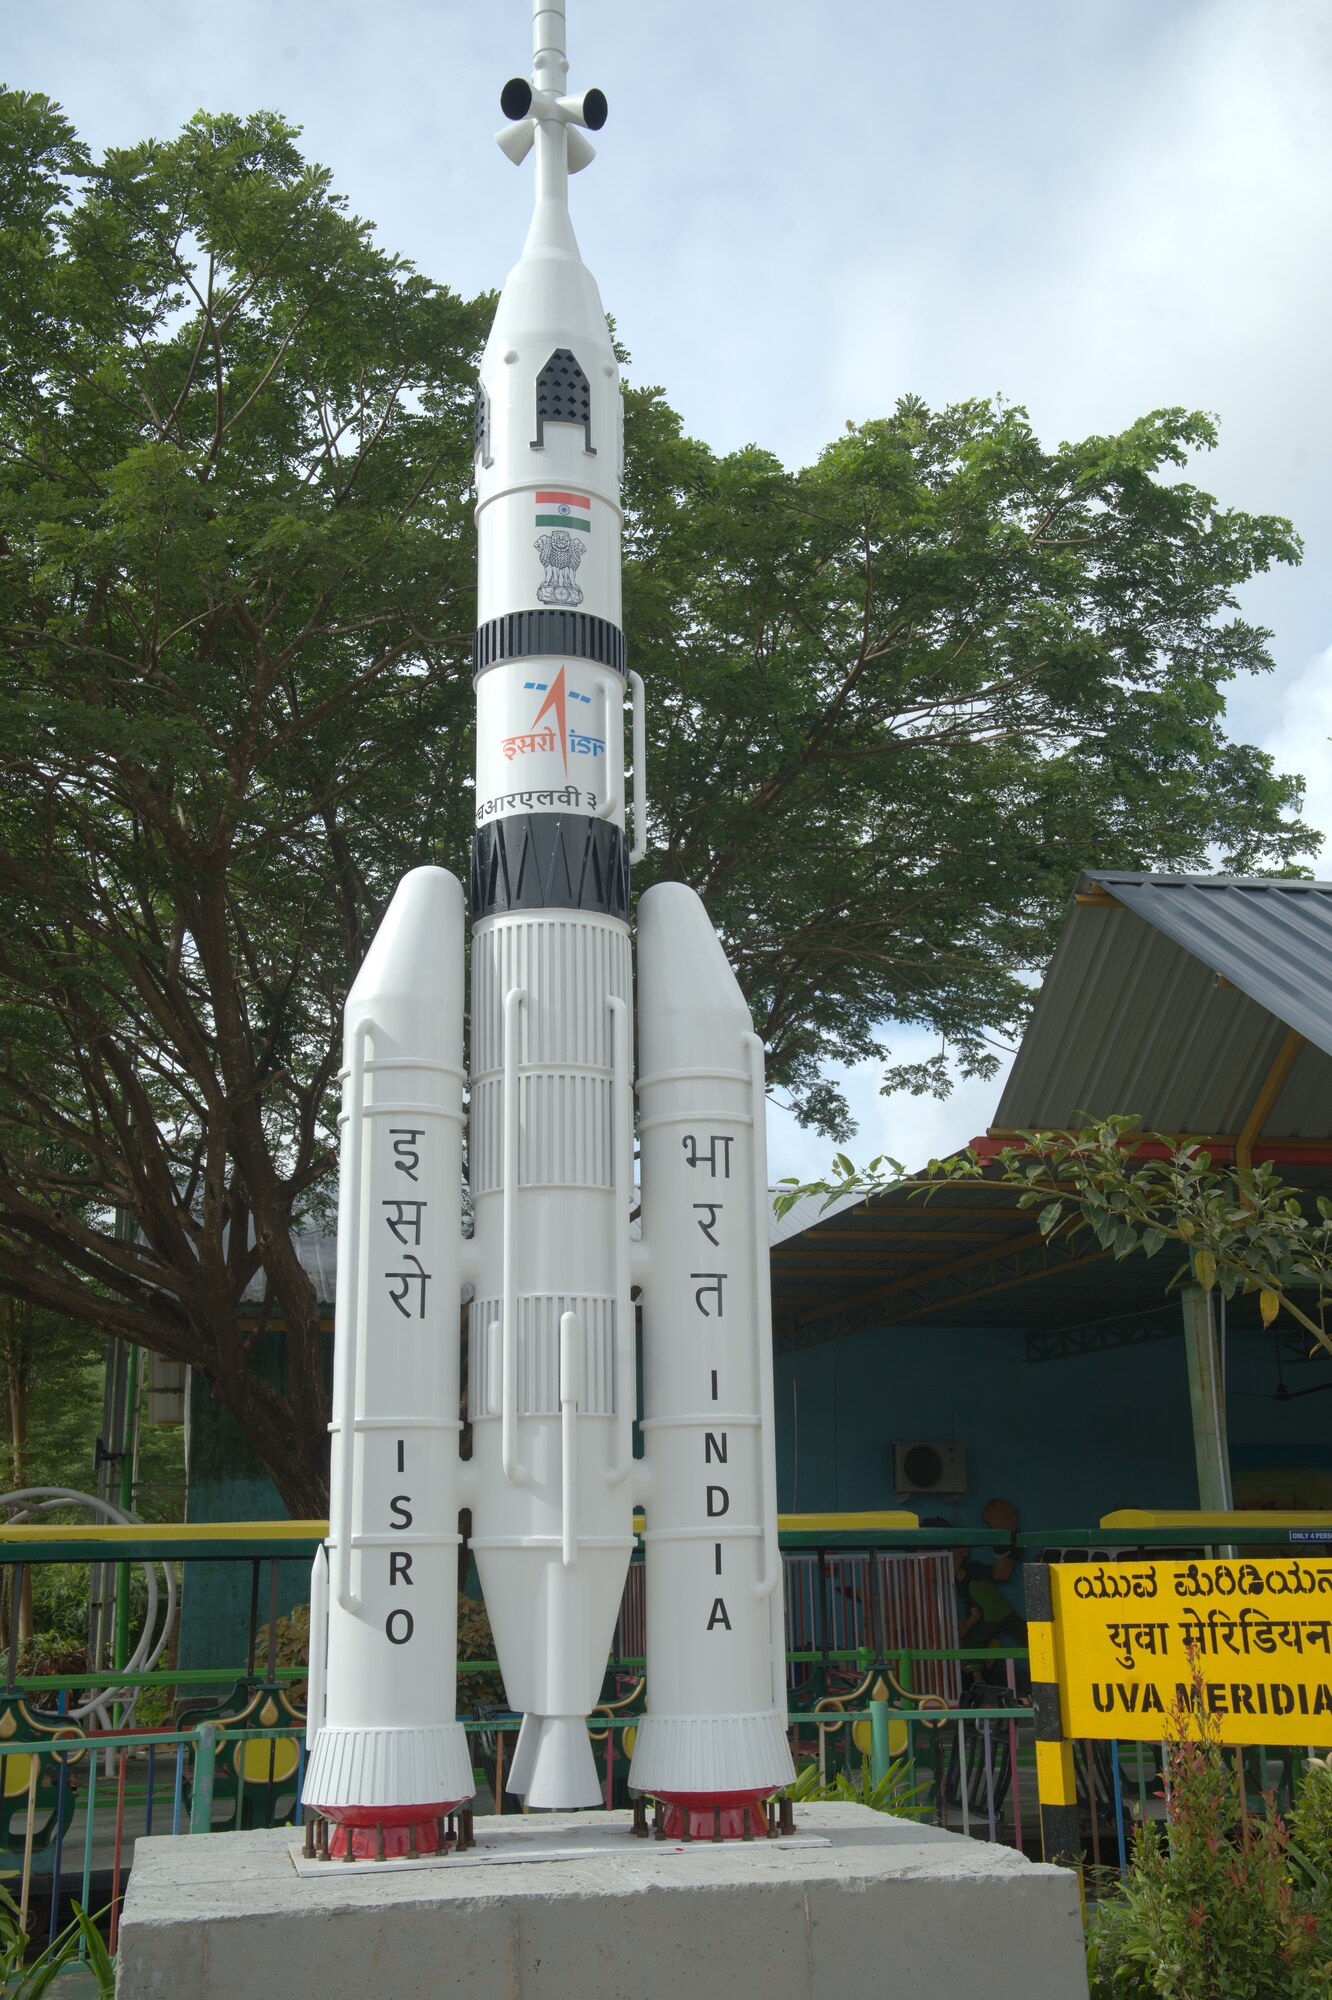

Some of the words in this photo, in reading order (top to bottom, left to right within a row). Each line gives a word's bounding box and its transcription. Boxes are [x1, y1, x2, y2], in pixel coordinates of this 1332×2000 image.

[501, 726, 556, 761] इसरो
[568, 728, 606, 757] isr
[476, 785, 582, 820] चआरएलवी
[382, 1129, 432, 1319] इसरो
[682, 1134, 734, 1318] भारत
[704, 1369, 732, 1631] INDIA
[385, 1439, 414, 1645] ISRO
[1292, 1532, 1309, 1540] ONLY
[1074, 1565, 1158, 1599] ಯುವ
[1106, 1622, 1169, 1670] युवा
[1178, 1607, 1332, 1655] मेरिडियन
[1091, 1682, 1165, 1714] UVA
[1175, 1682, 1332, 1716] MERIDIA
